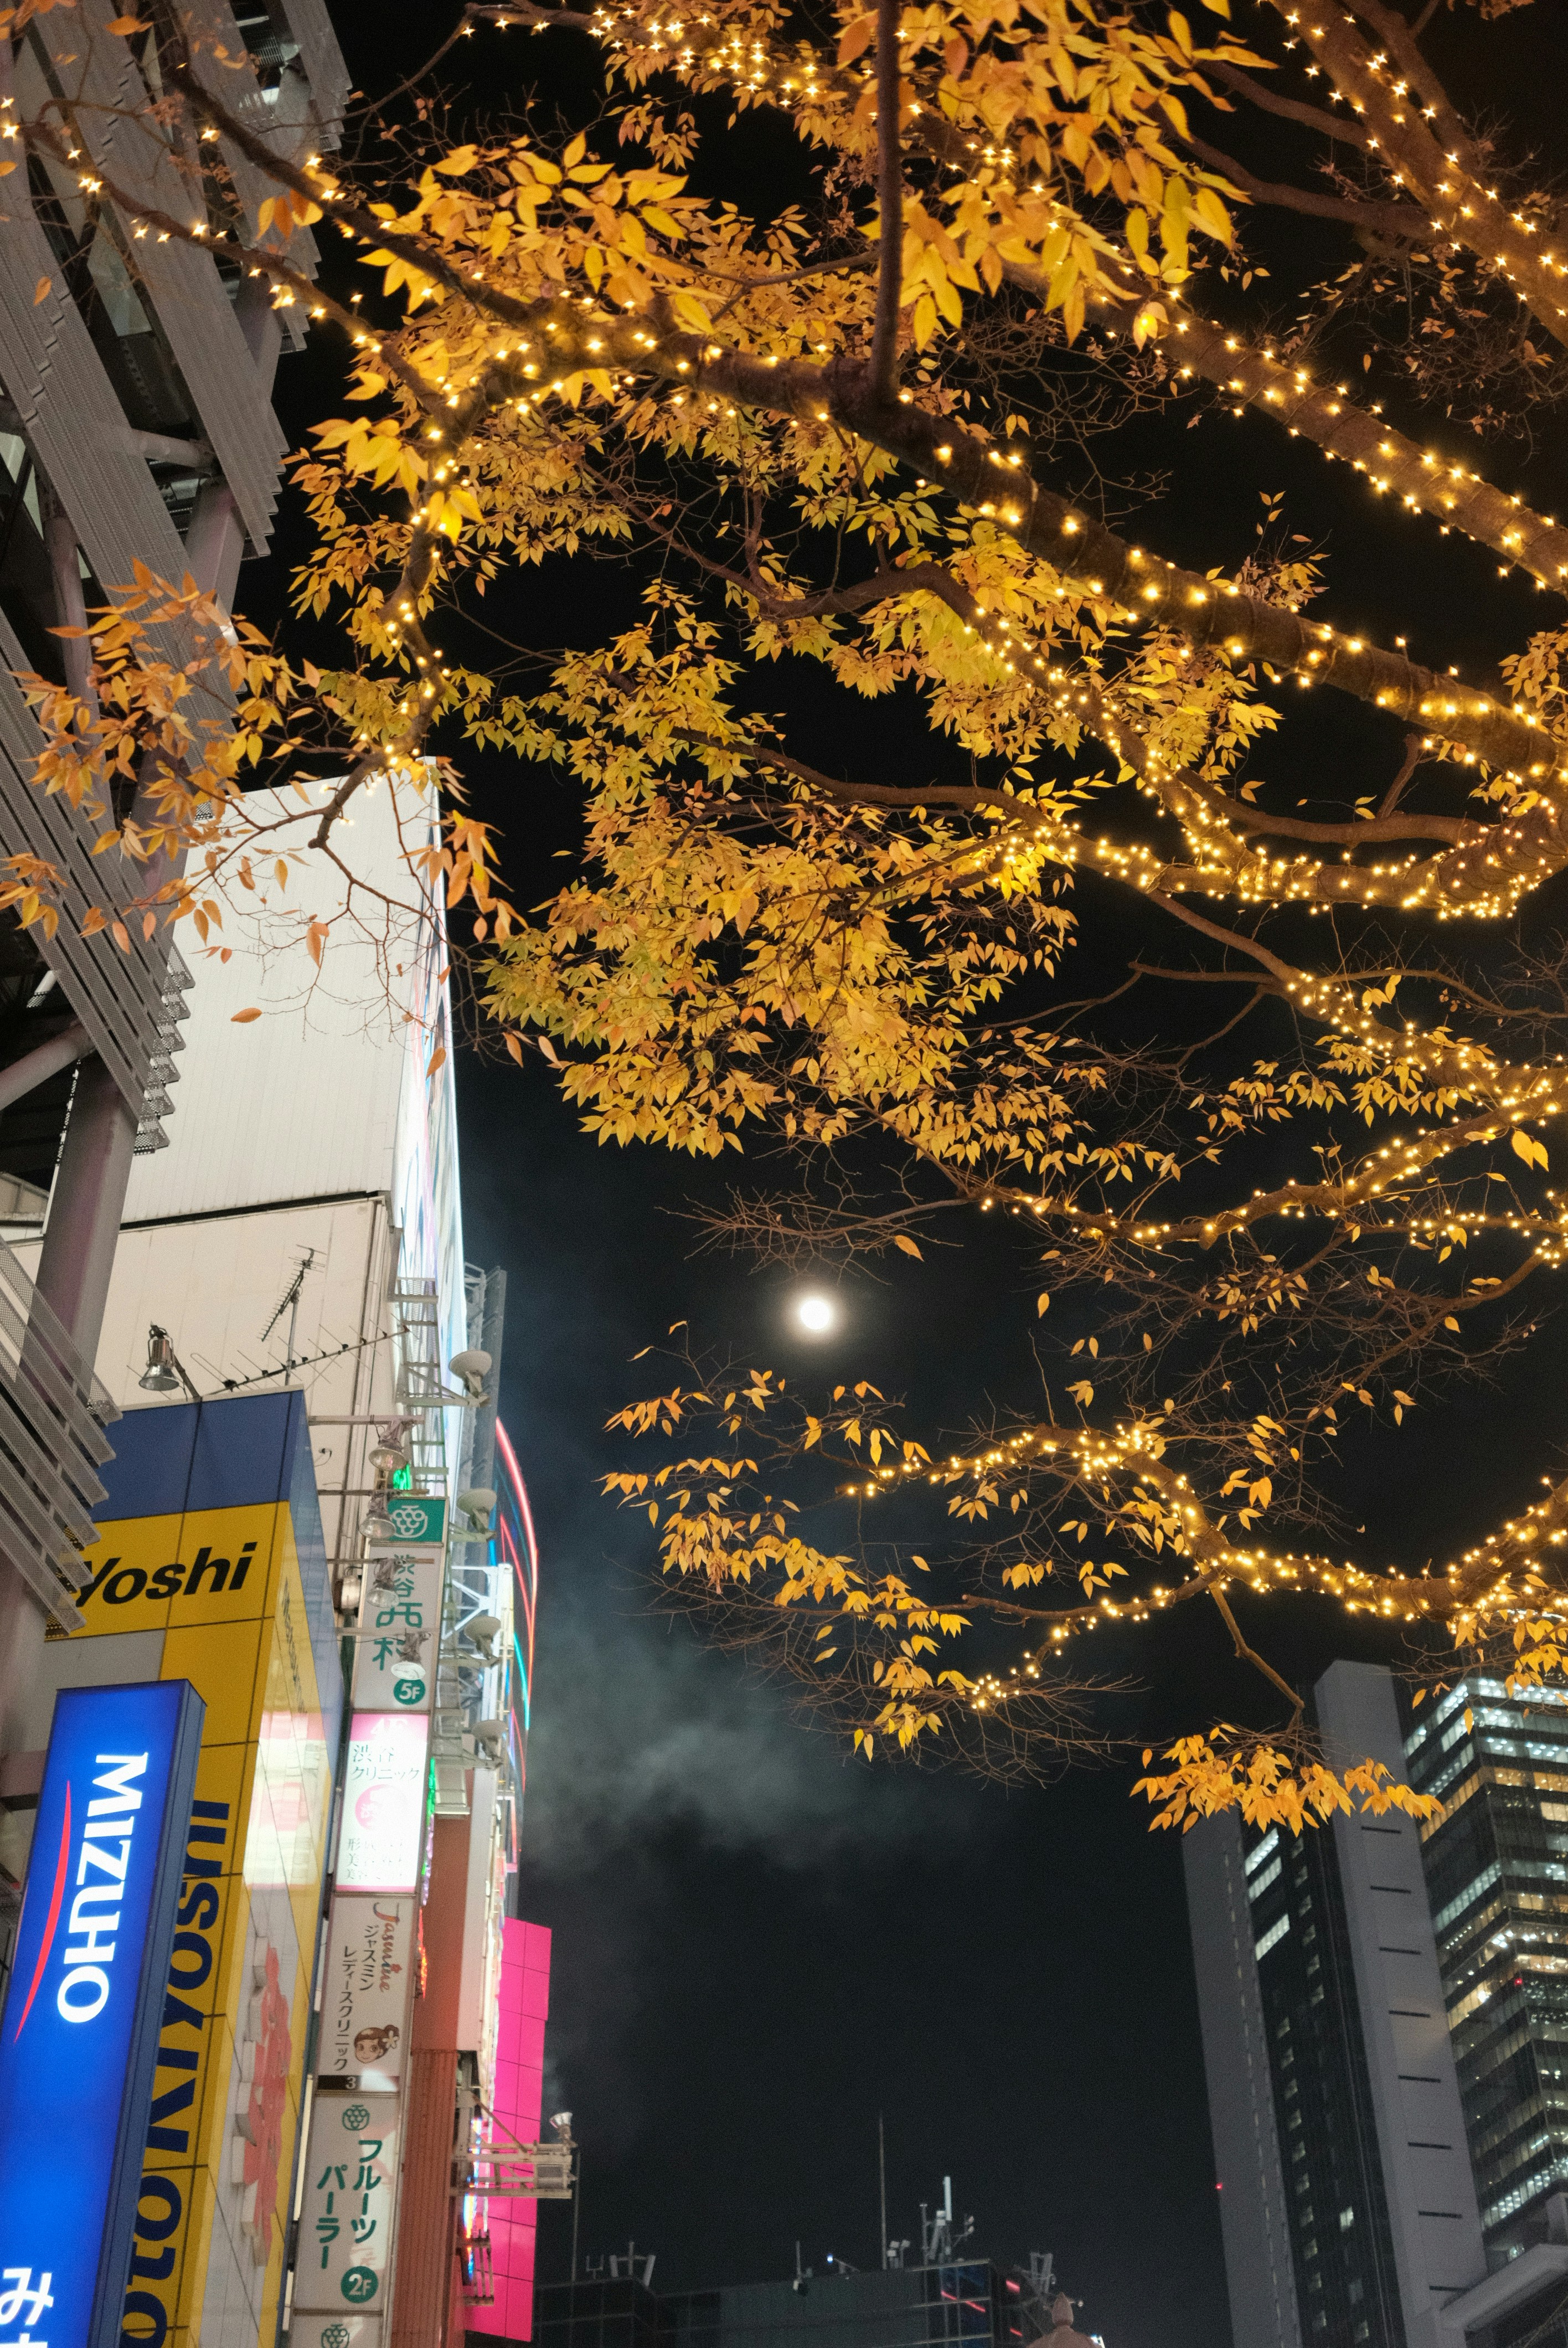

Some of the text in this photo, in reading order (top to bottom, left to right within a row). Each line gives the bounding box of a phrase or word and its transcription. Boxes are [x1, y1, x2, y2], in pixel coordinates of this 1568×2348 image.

[399, 1682, 421, 1700] 5F
[351, 1766, 420, 1781] クリニック
[57, 1752, 149, 2023] MIZUHO
[359, 1925, 379, 1991] ジャスミン
[373, 1902, 403, 1992] Jasmine
[334, 1945, 358, 2072] レディースクリニック
[316, 2164, 348, 2269] パーラー
[351, 2140, 382, 2244] フルーツ
[0, 2267, 54, 2348] み
[349, 2273, 372, 2295] 2F
